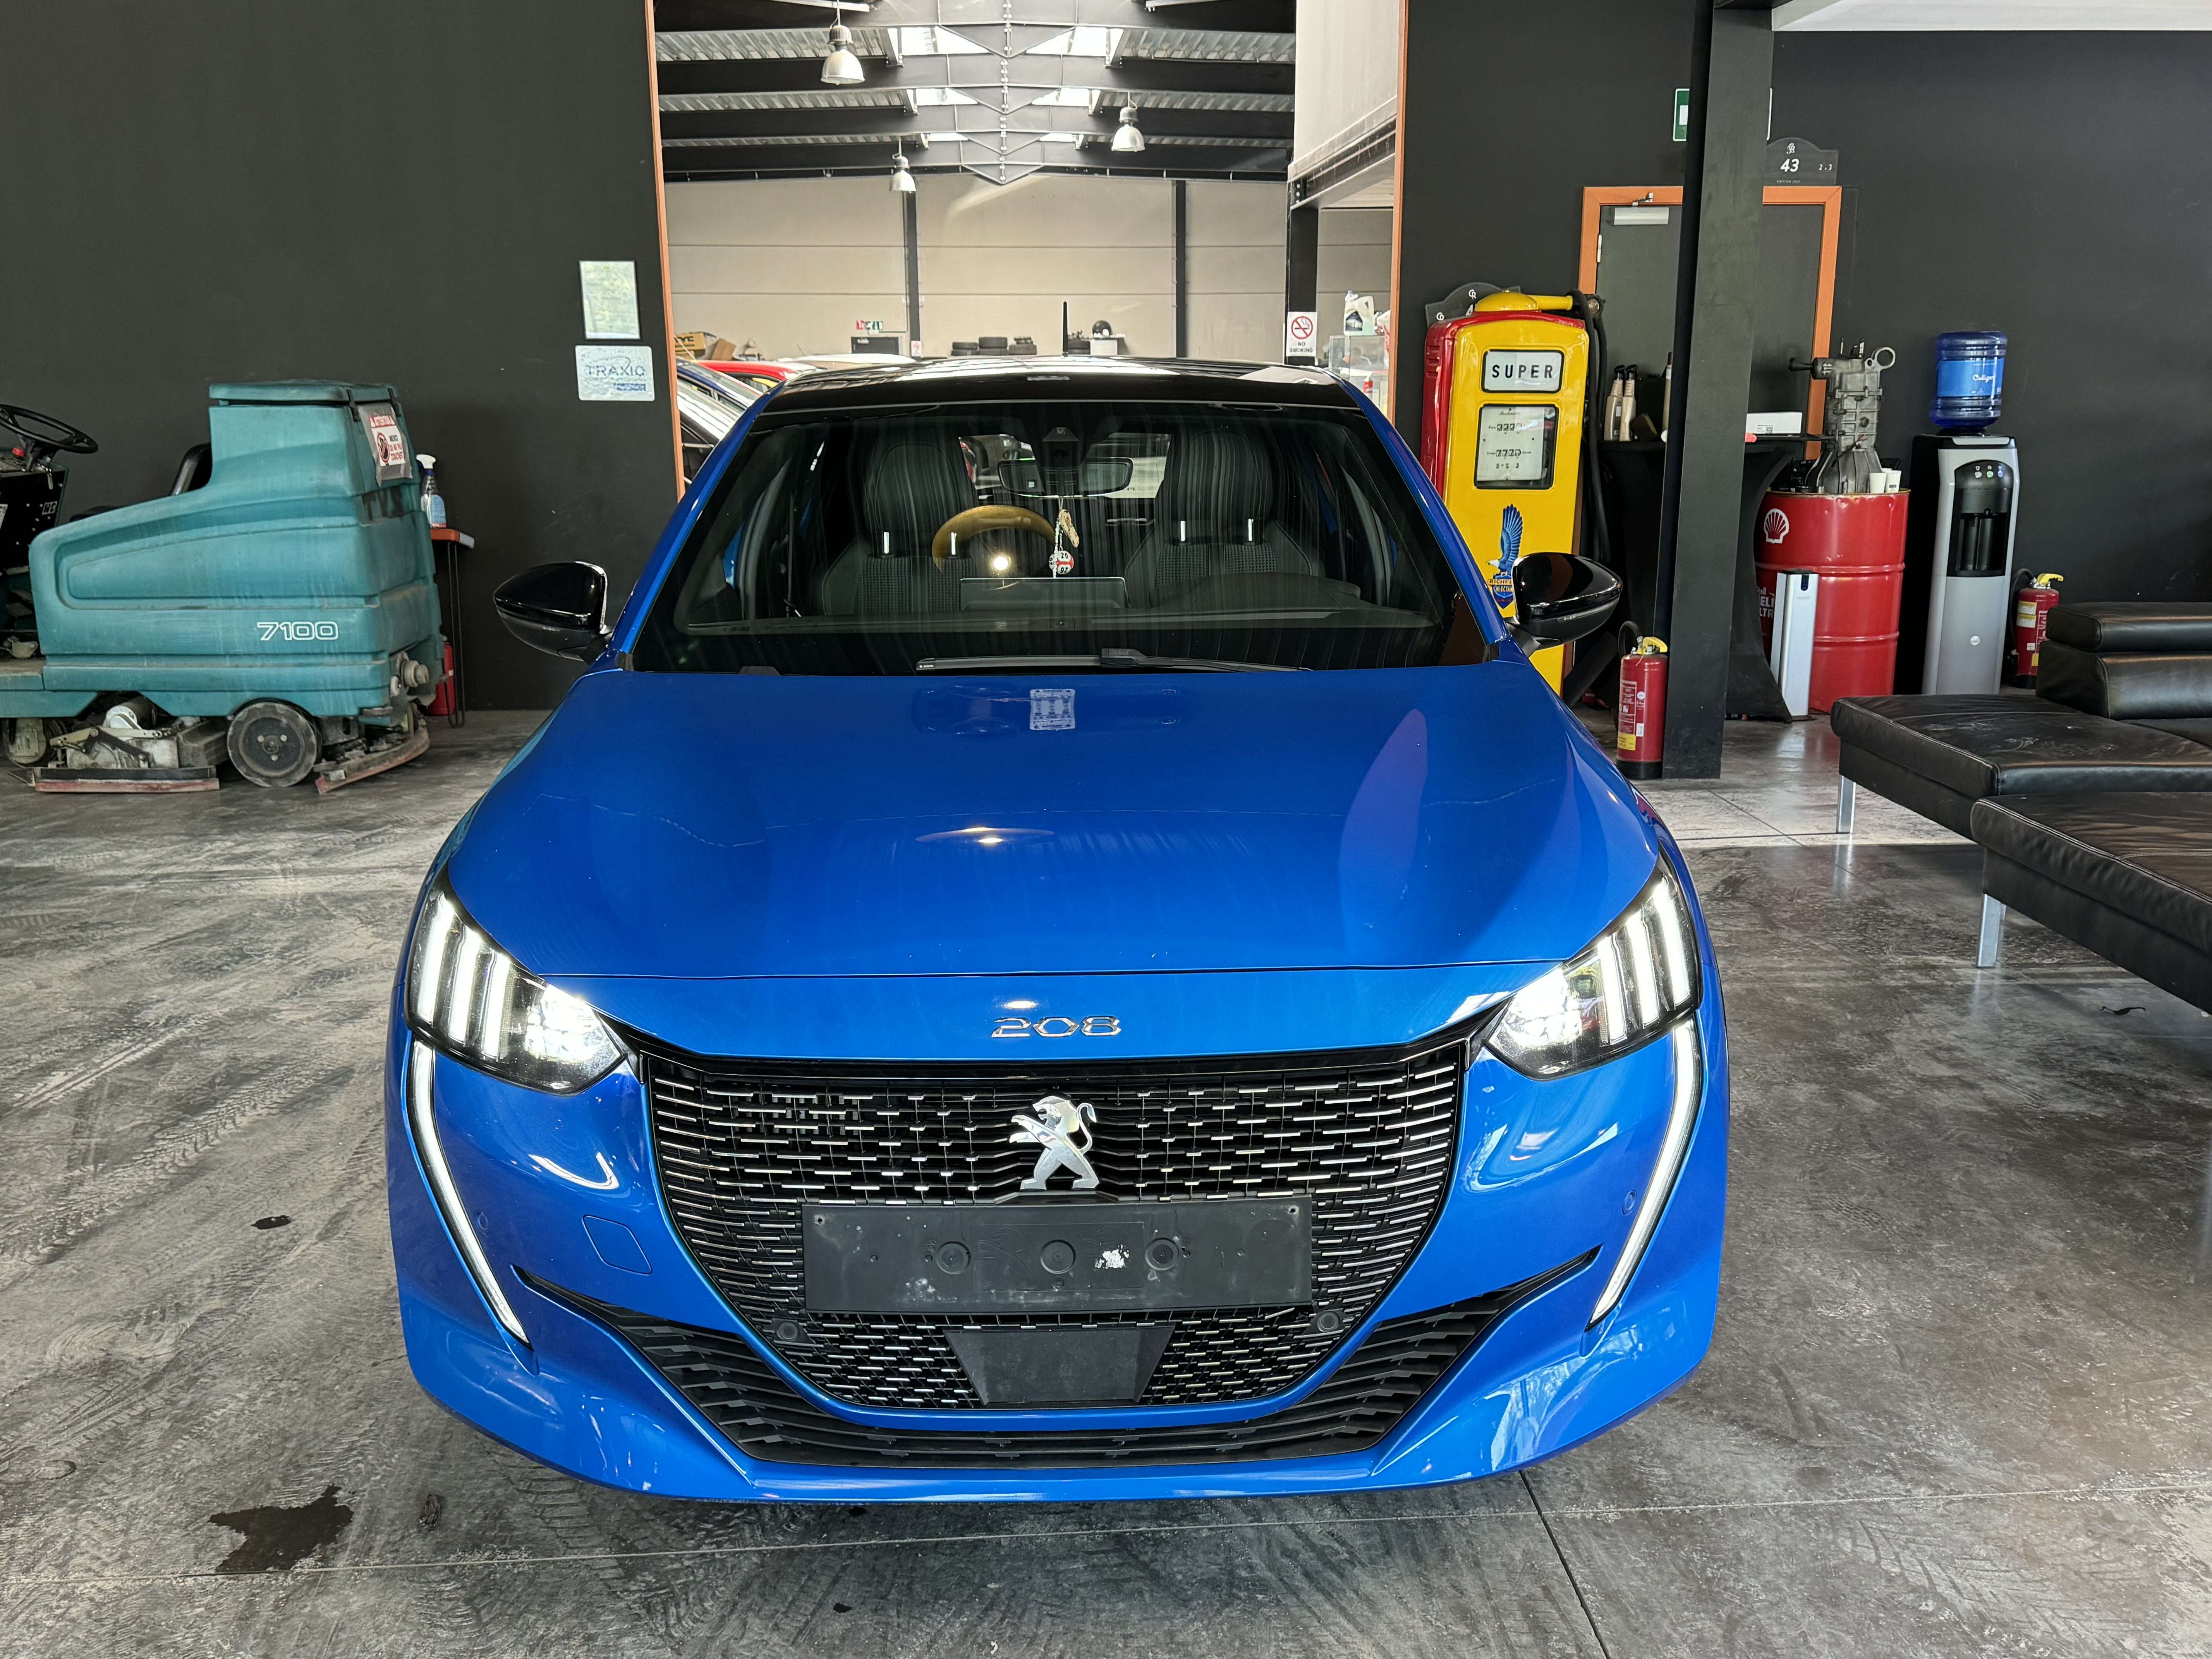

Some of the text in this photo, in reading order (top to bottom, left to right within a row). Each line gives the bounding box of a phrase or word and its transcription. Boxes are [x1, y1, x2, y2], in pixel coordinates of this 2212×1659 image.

[1780, 158, 1800, 172] 43
[1492, 364, 1553, 378] SUPER
[257, 621, 338, 641] 7100
[991, 1015, 1121, 1038] 208
